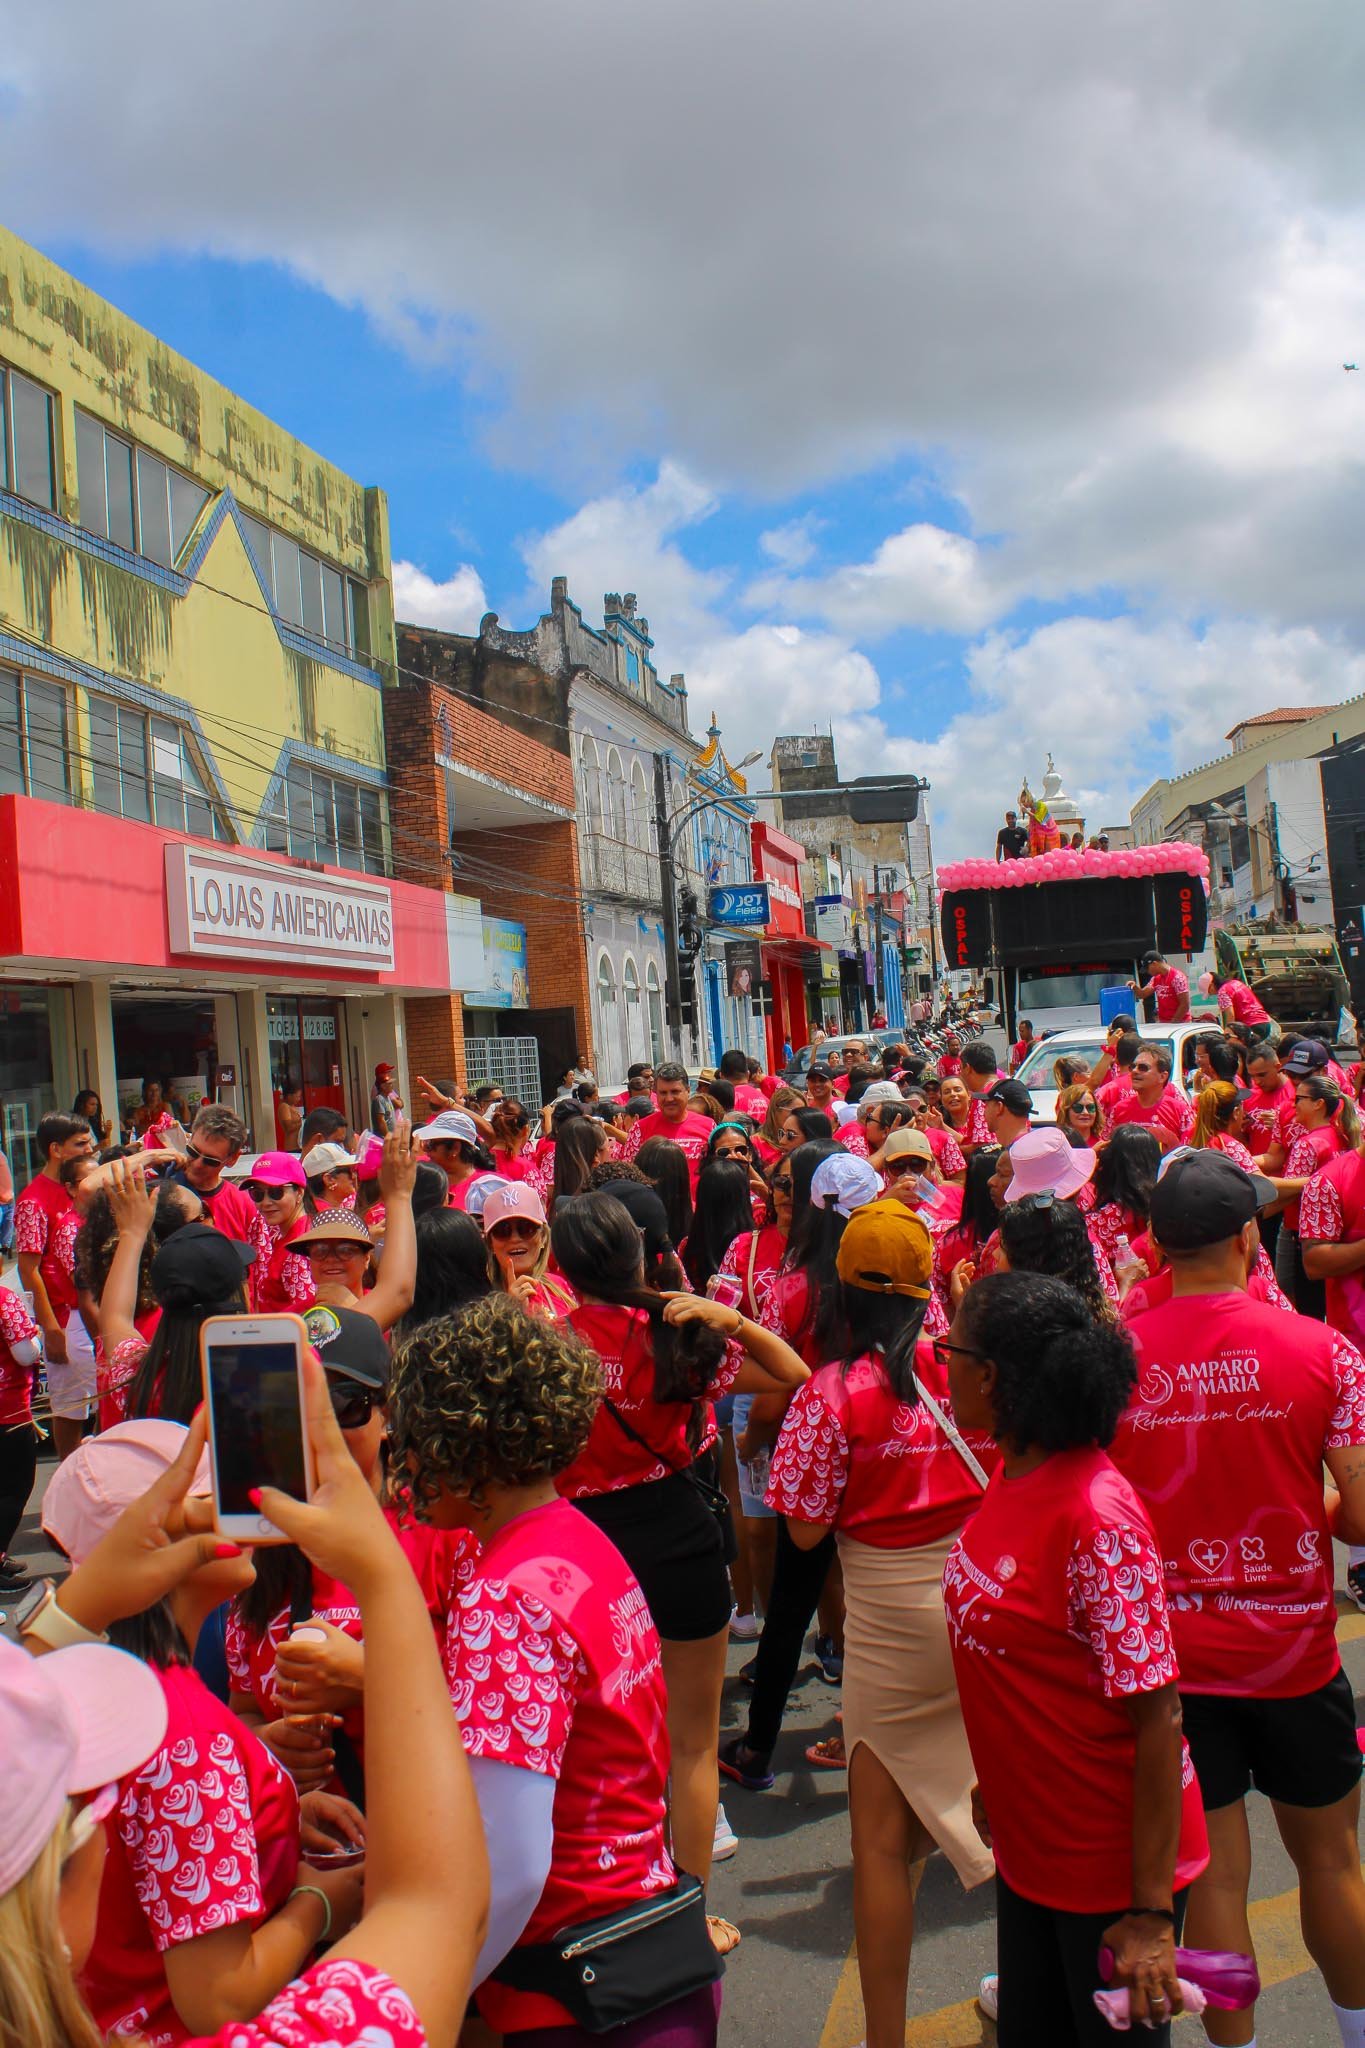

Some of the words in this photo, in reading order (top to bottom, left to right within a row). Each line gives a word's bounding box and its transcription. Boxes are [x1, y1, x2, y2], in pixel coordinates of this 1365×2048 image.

[190, 876, 265, 930] LOJAS
[272, 891, 391, 947] AMERICANAS
[735, 907, 764, 916] FIBER
[1179, 888, 1192, 949] OSPAL
[954, 907, 968, 966] OSPAL
[1176, 1358, 1260, 1381] AMPARO
[1180, 1383, 1193, 1393] DE
[1199, 1375, 1261, 1396] MARIA
[1243, 1562, 1273, 1573] Saúde
[1244, 1573, 1267, 1583] Livre
[1234, 1600, 1328, 1615] Mitermayer
